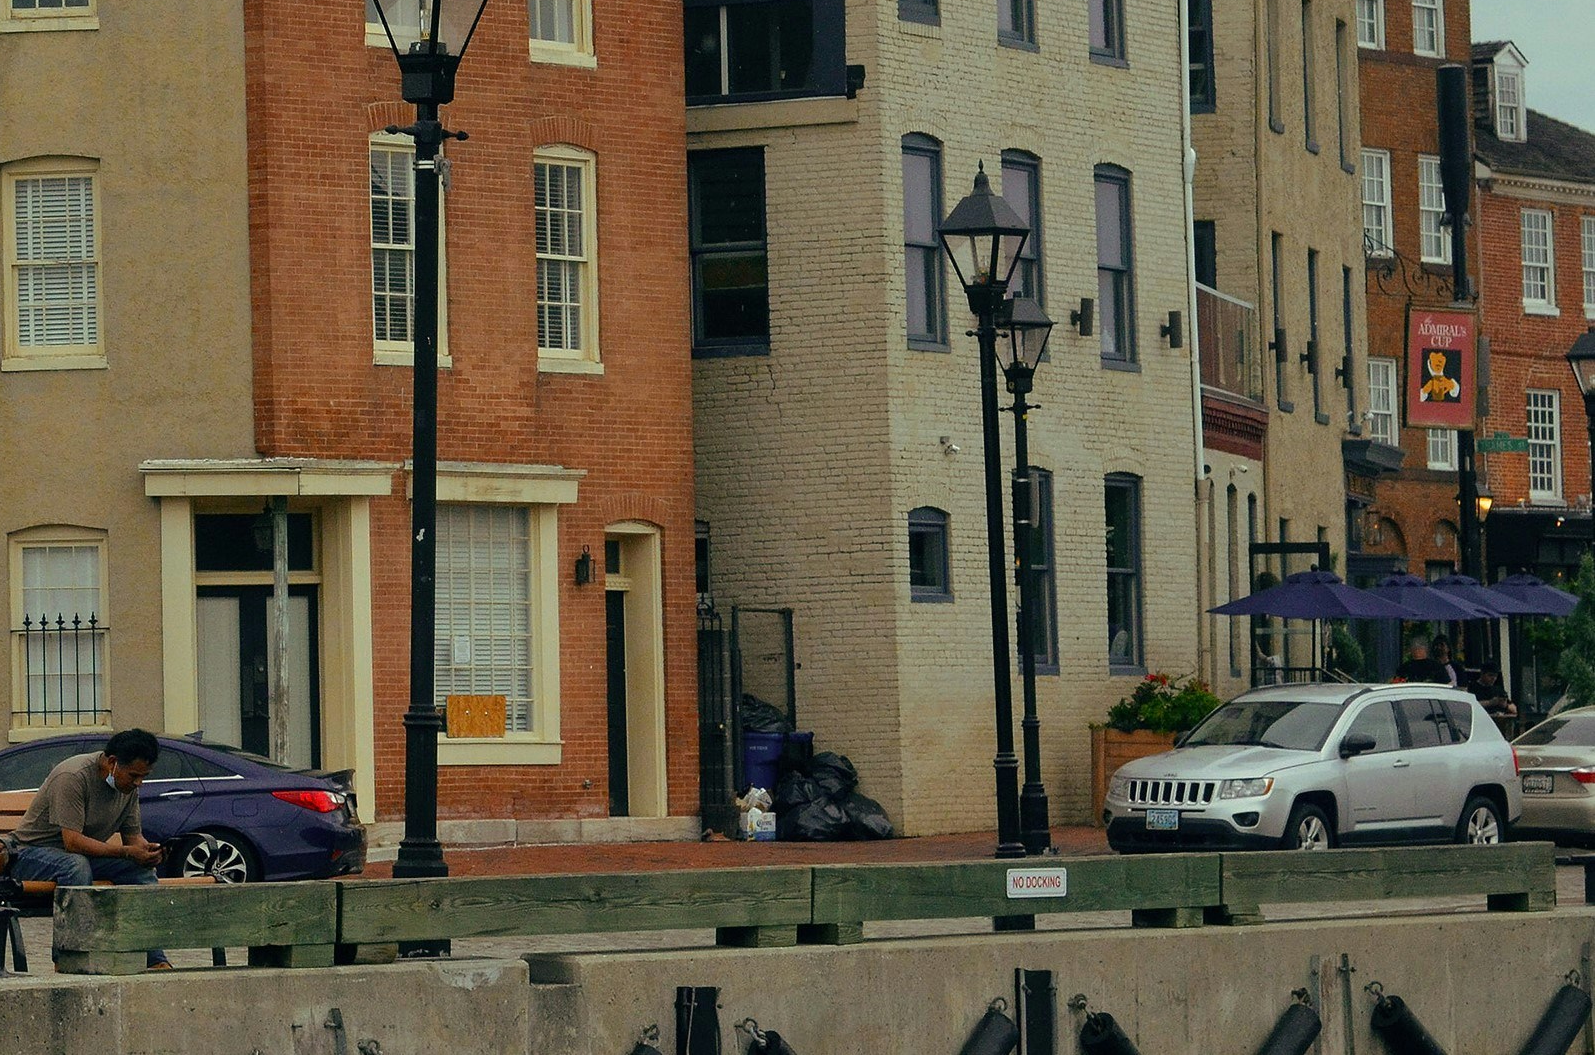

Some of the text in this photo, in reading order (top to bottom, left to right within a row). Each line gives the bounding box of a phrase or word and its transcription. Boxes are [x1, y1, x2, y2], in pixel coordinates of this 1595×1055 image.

[1430, 336, 1453, 347] CUP
[1012, 875, 1061, 889] NO DOCKING
